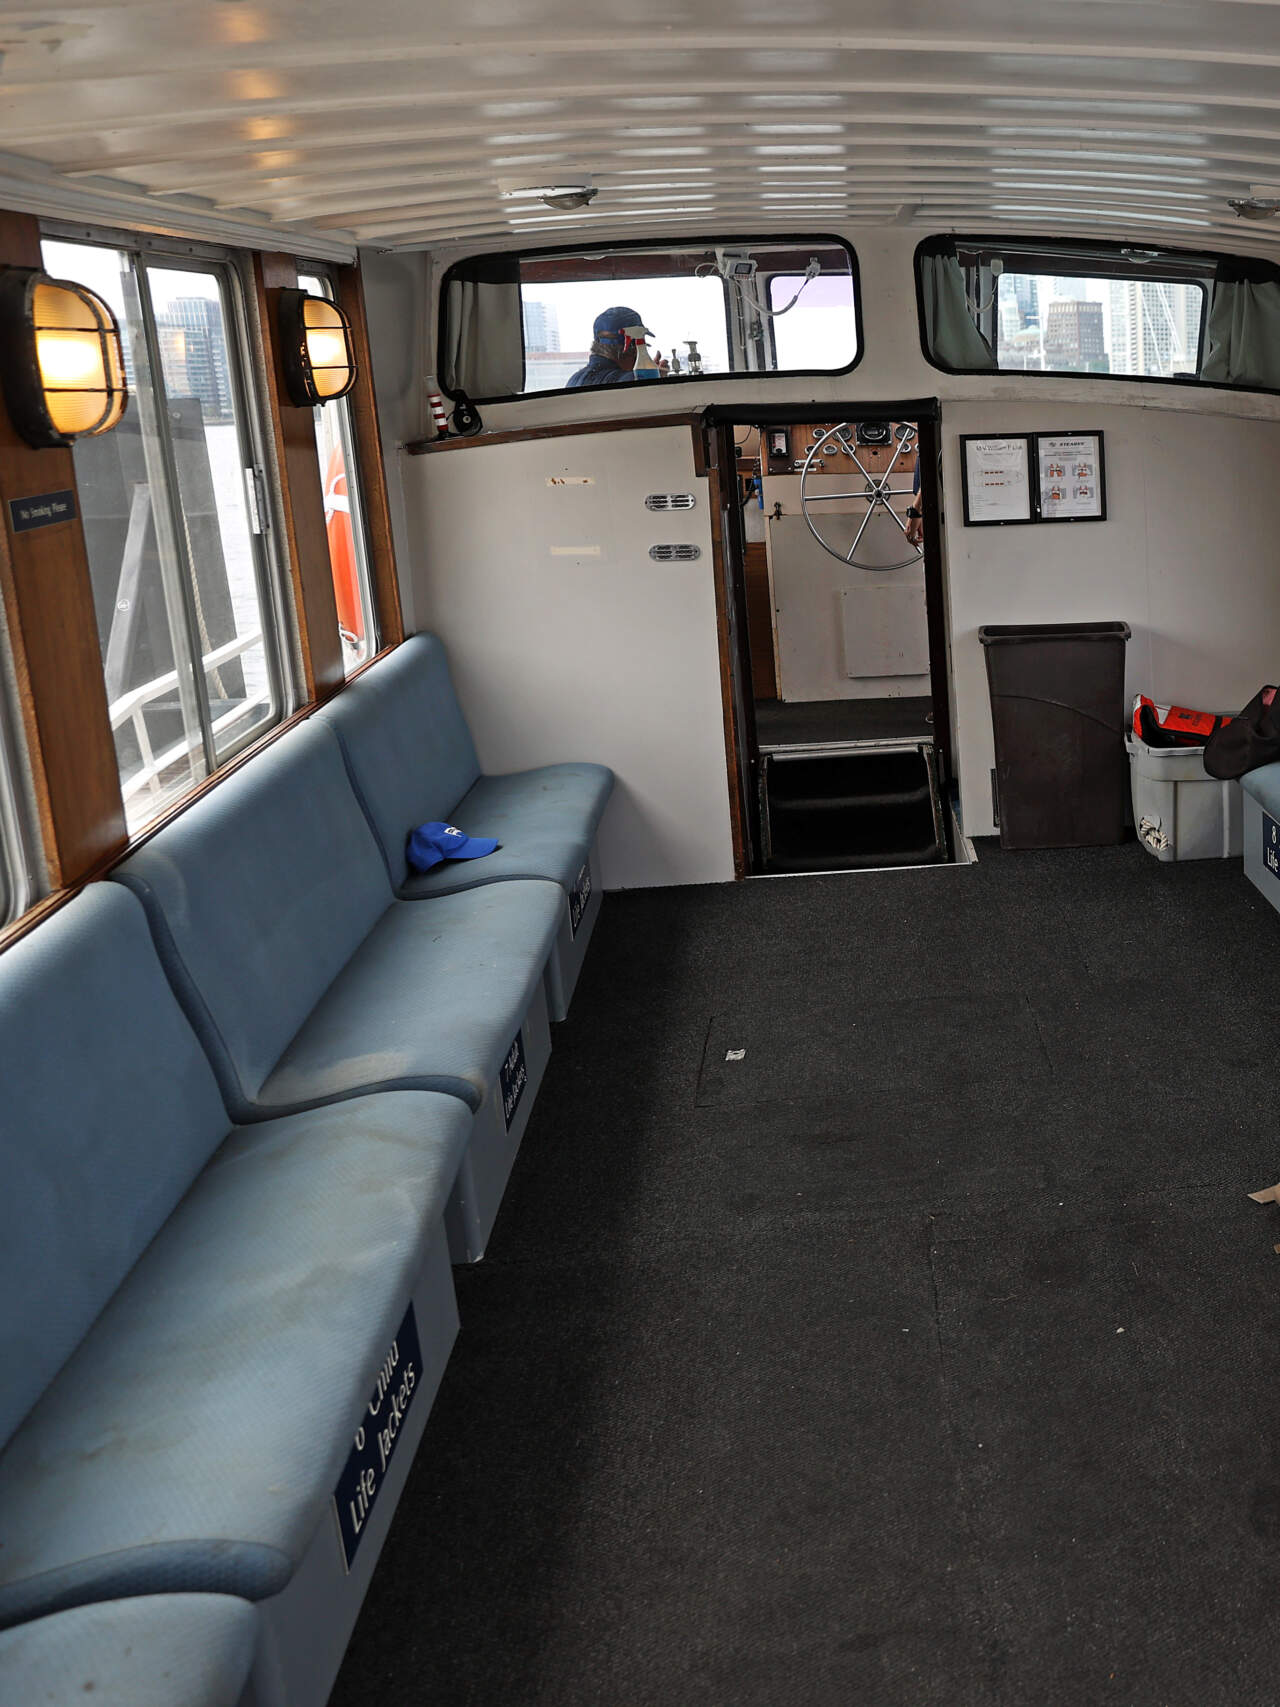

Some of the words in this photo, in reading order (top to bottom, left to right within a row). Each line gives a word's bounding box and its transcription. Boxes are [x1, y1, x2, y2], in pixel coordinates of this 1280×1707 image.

[30, 506, 52, 518] Smoking
[1271, 825, 1277, 844] 8
[1267, 847, 1278, 873] Life
[350, 1468, 376, 1534] Life
[377, 1361, 416, 1474] Jackets
